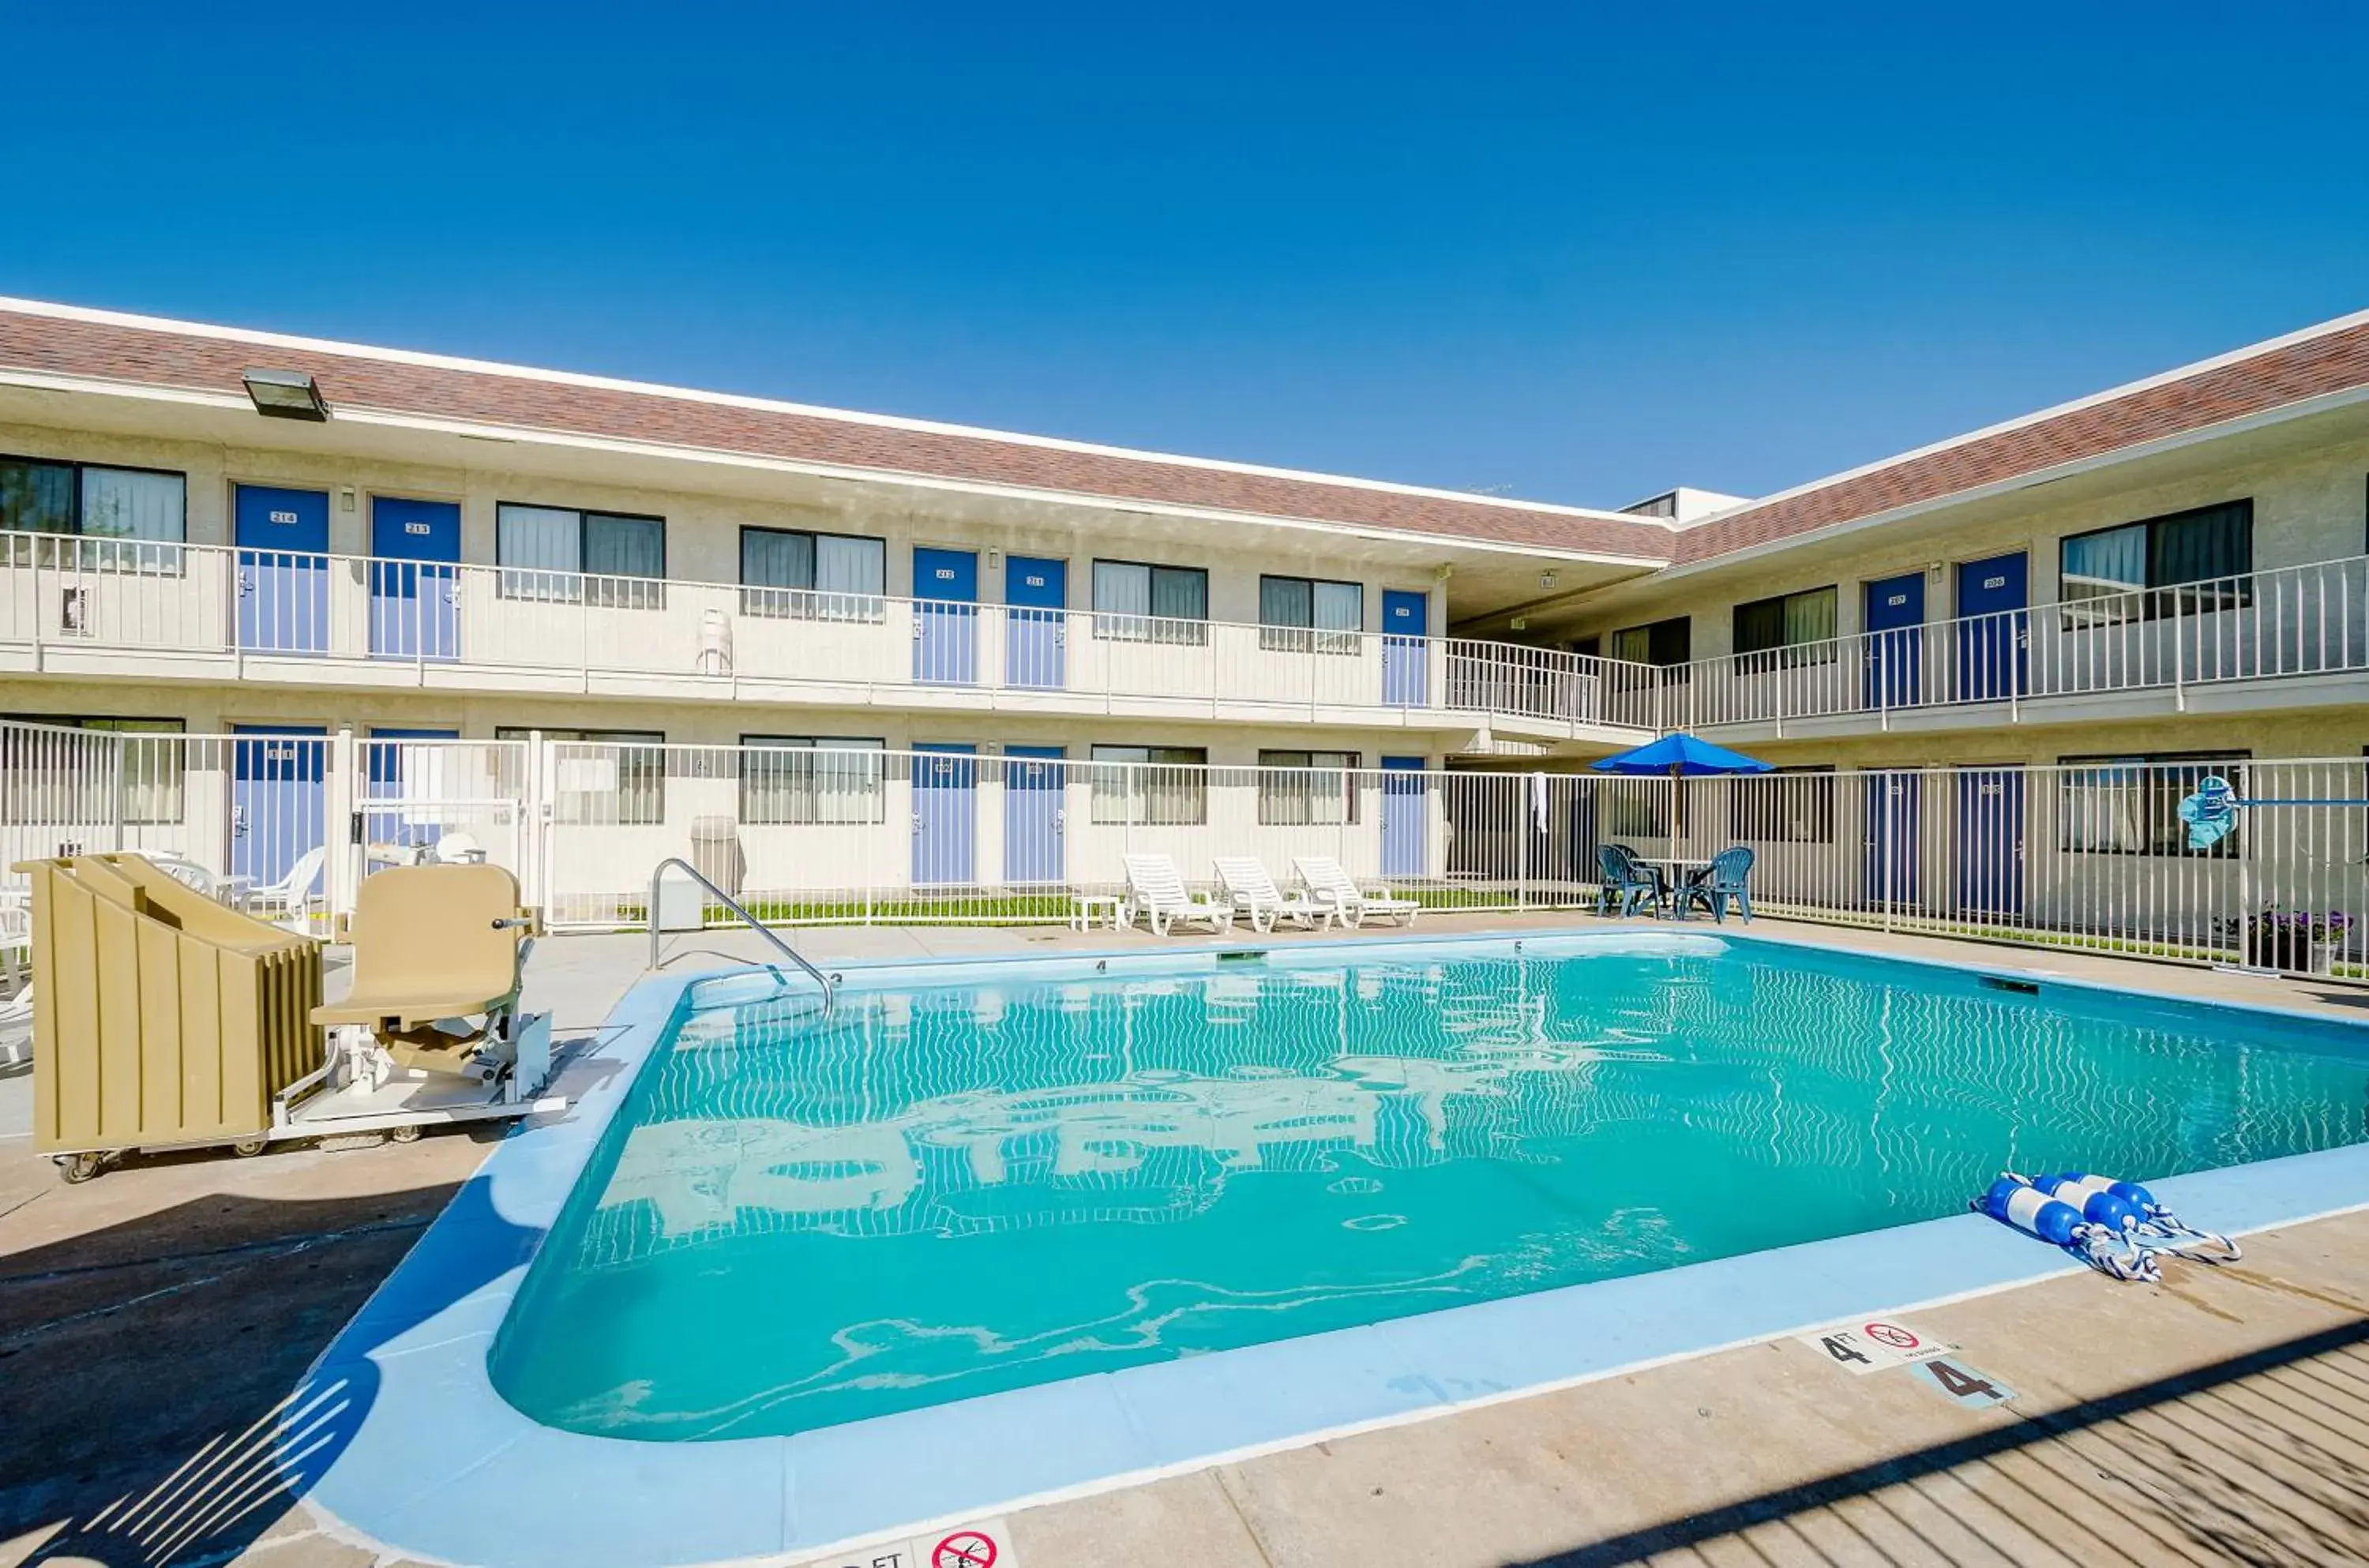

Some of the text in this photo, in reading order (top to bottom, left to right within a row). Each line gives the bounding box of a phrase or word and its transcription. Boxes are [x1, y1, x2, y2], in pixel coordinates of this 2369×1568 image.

[273, 513, 295, 522] 214
[1820, 1332, 1872, 1364] 4 FT
[1925, 1360, 2003, 1400] 4
